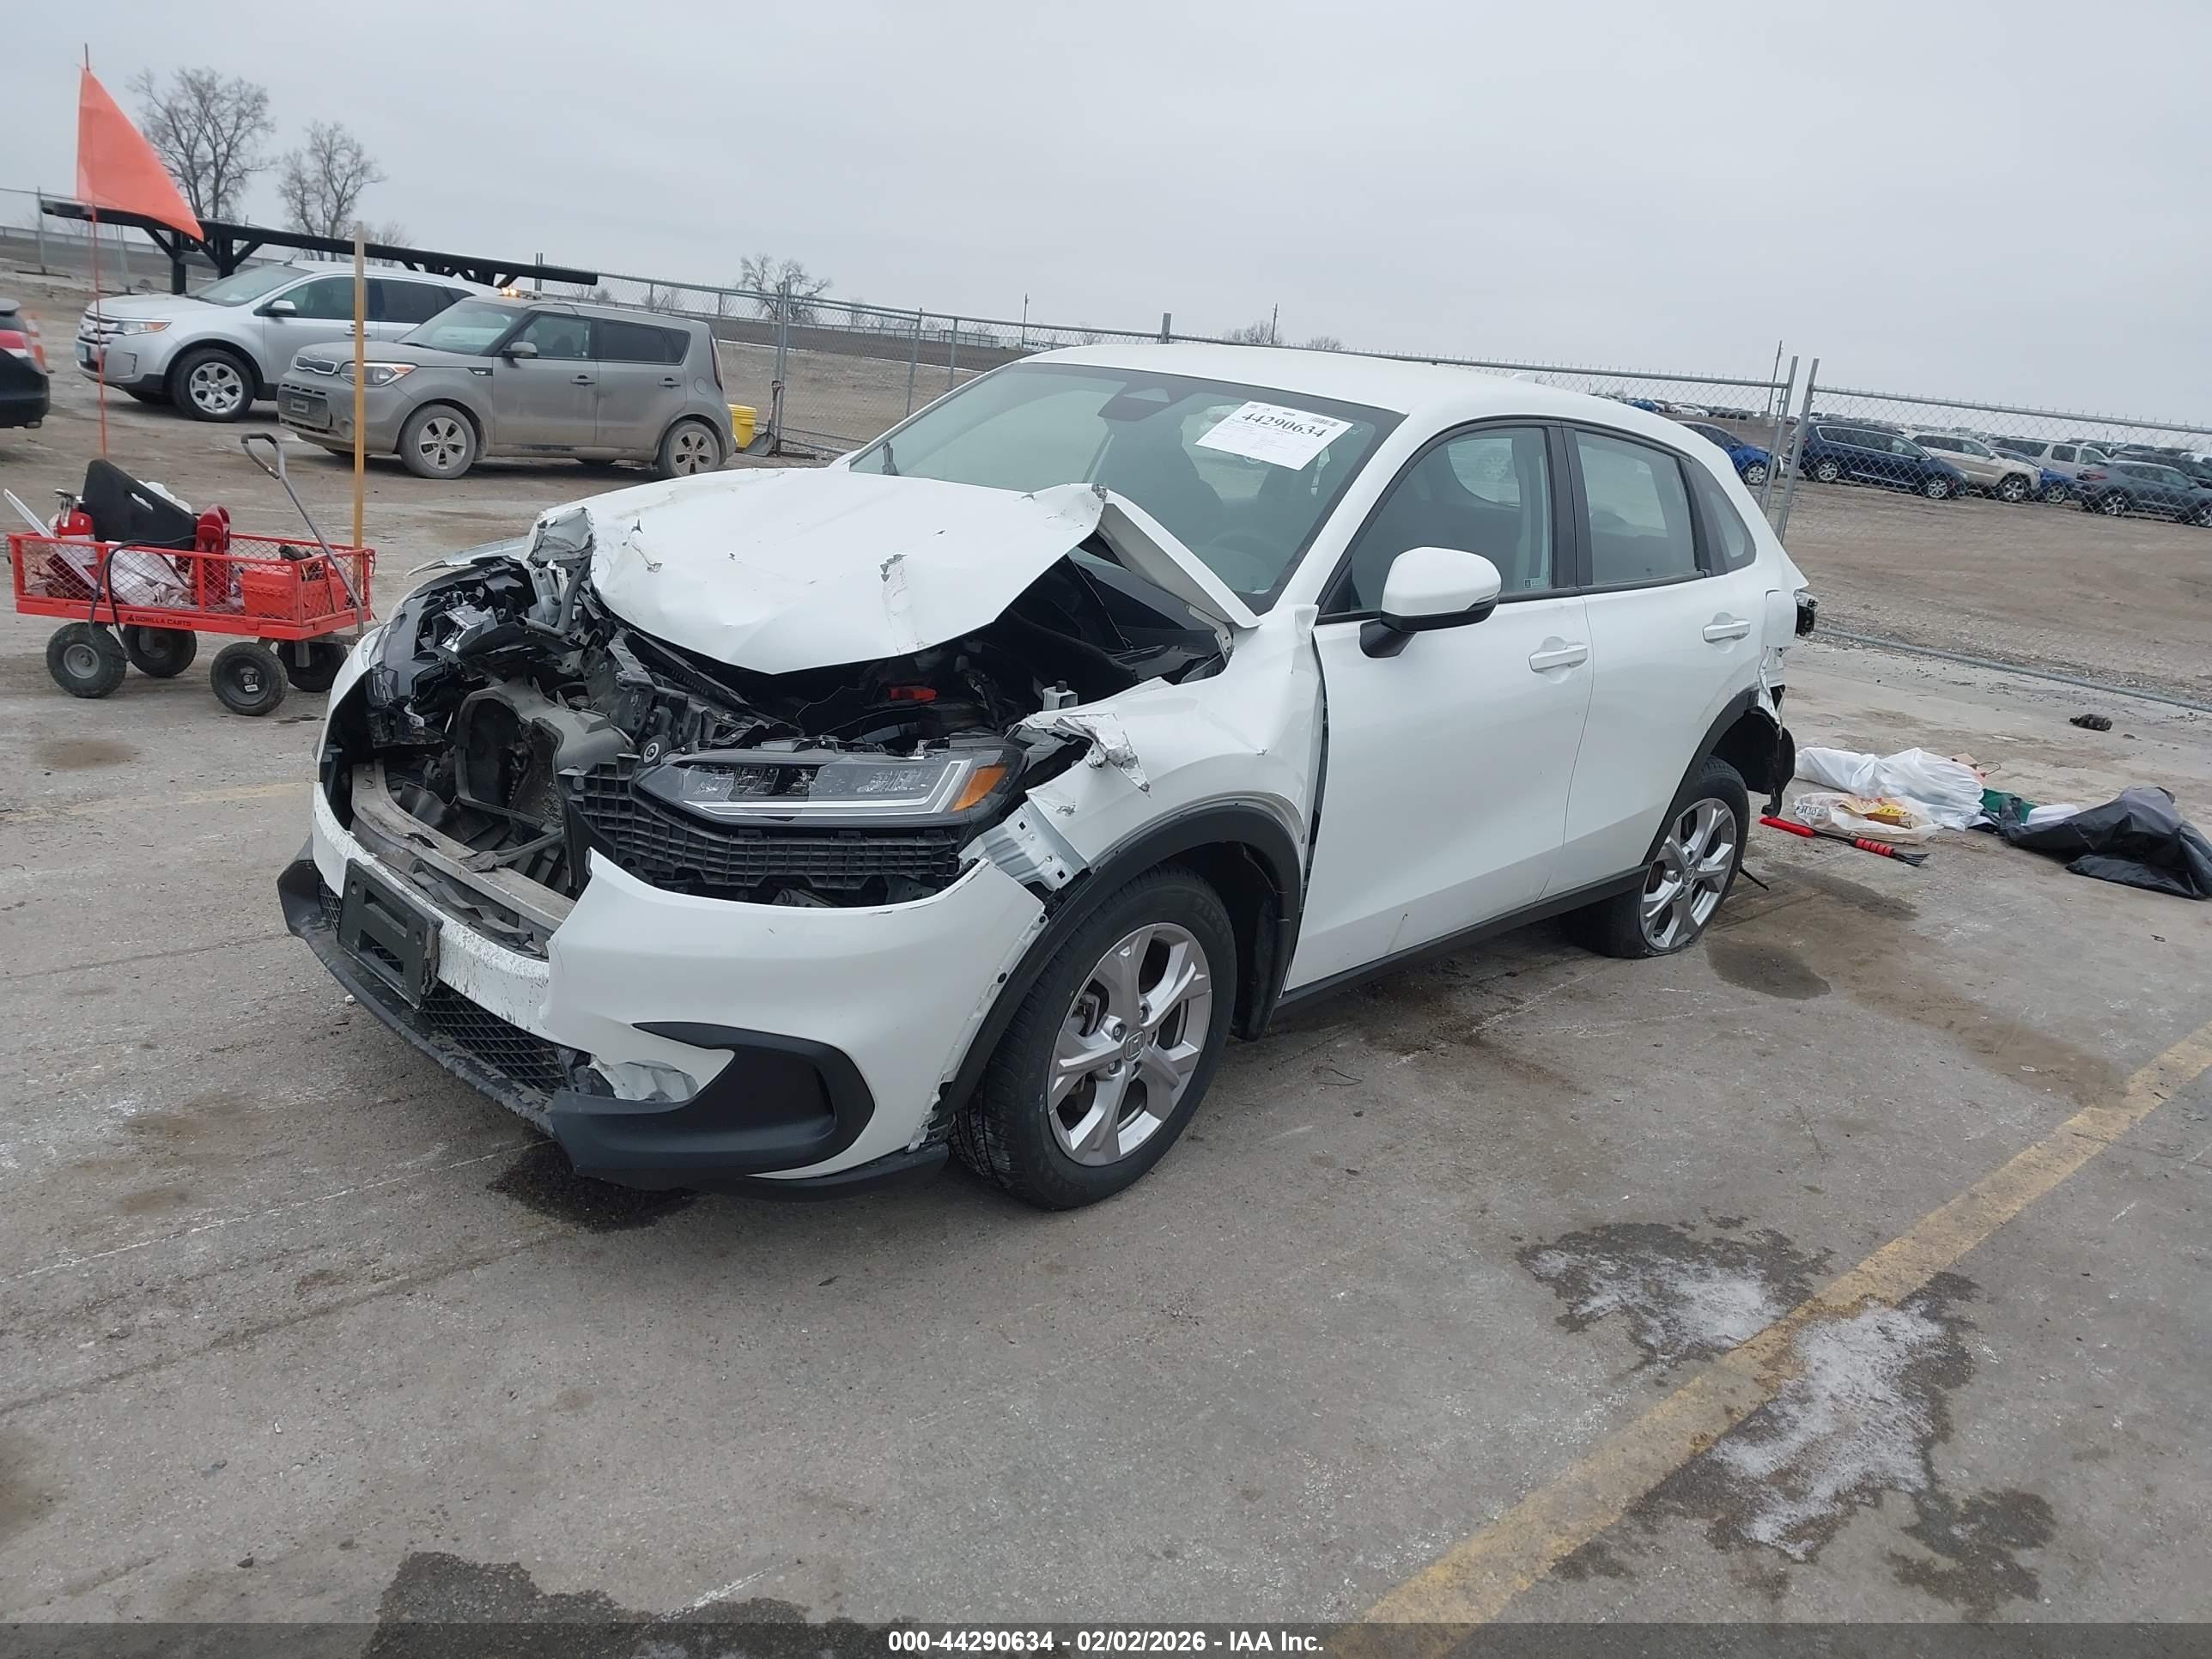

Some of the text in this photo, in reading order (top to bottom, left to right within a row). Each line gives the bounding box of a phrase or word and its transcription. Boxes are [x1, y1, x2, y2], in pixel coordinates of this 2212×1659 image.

[1242, 411, 1328, 438] 44290634
[135, 616, 192, 628] GORILLA CARTS
